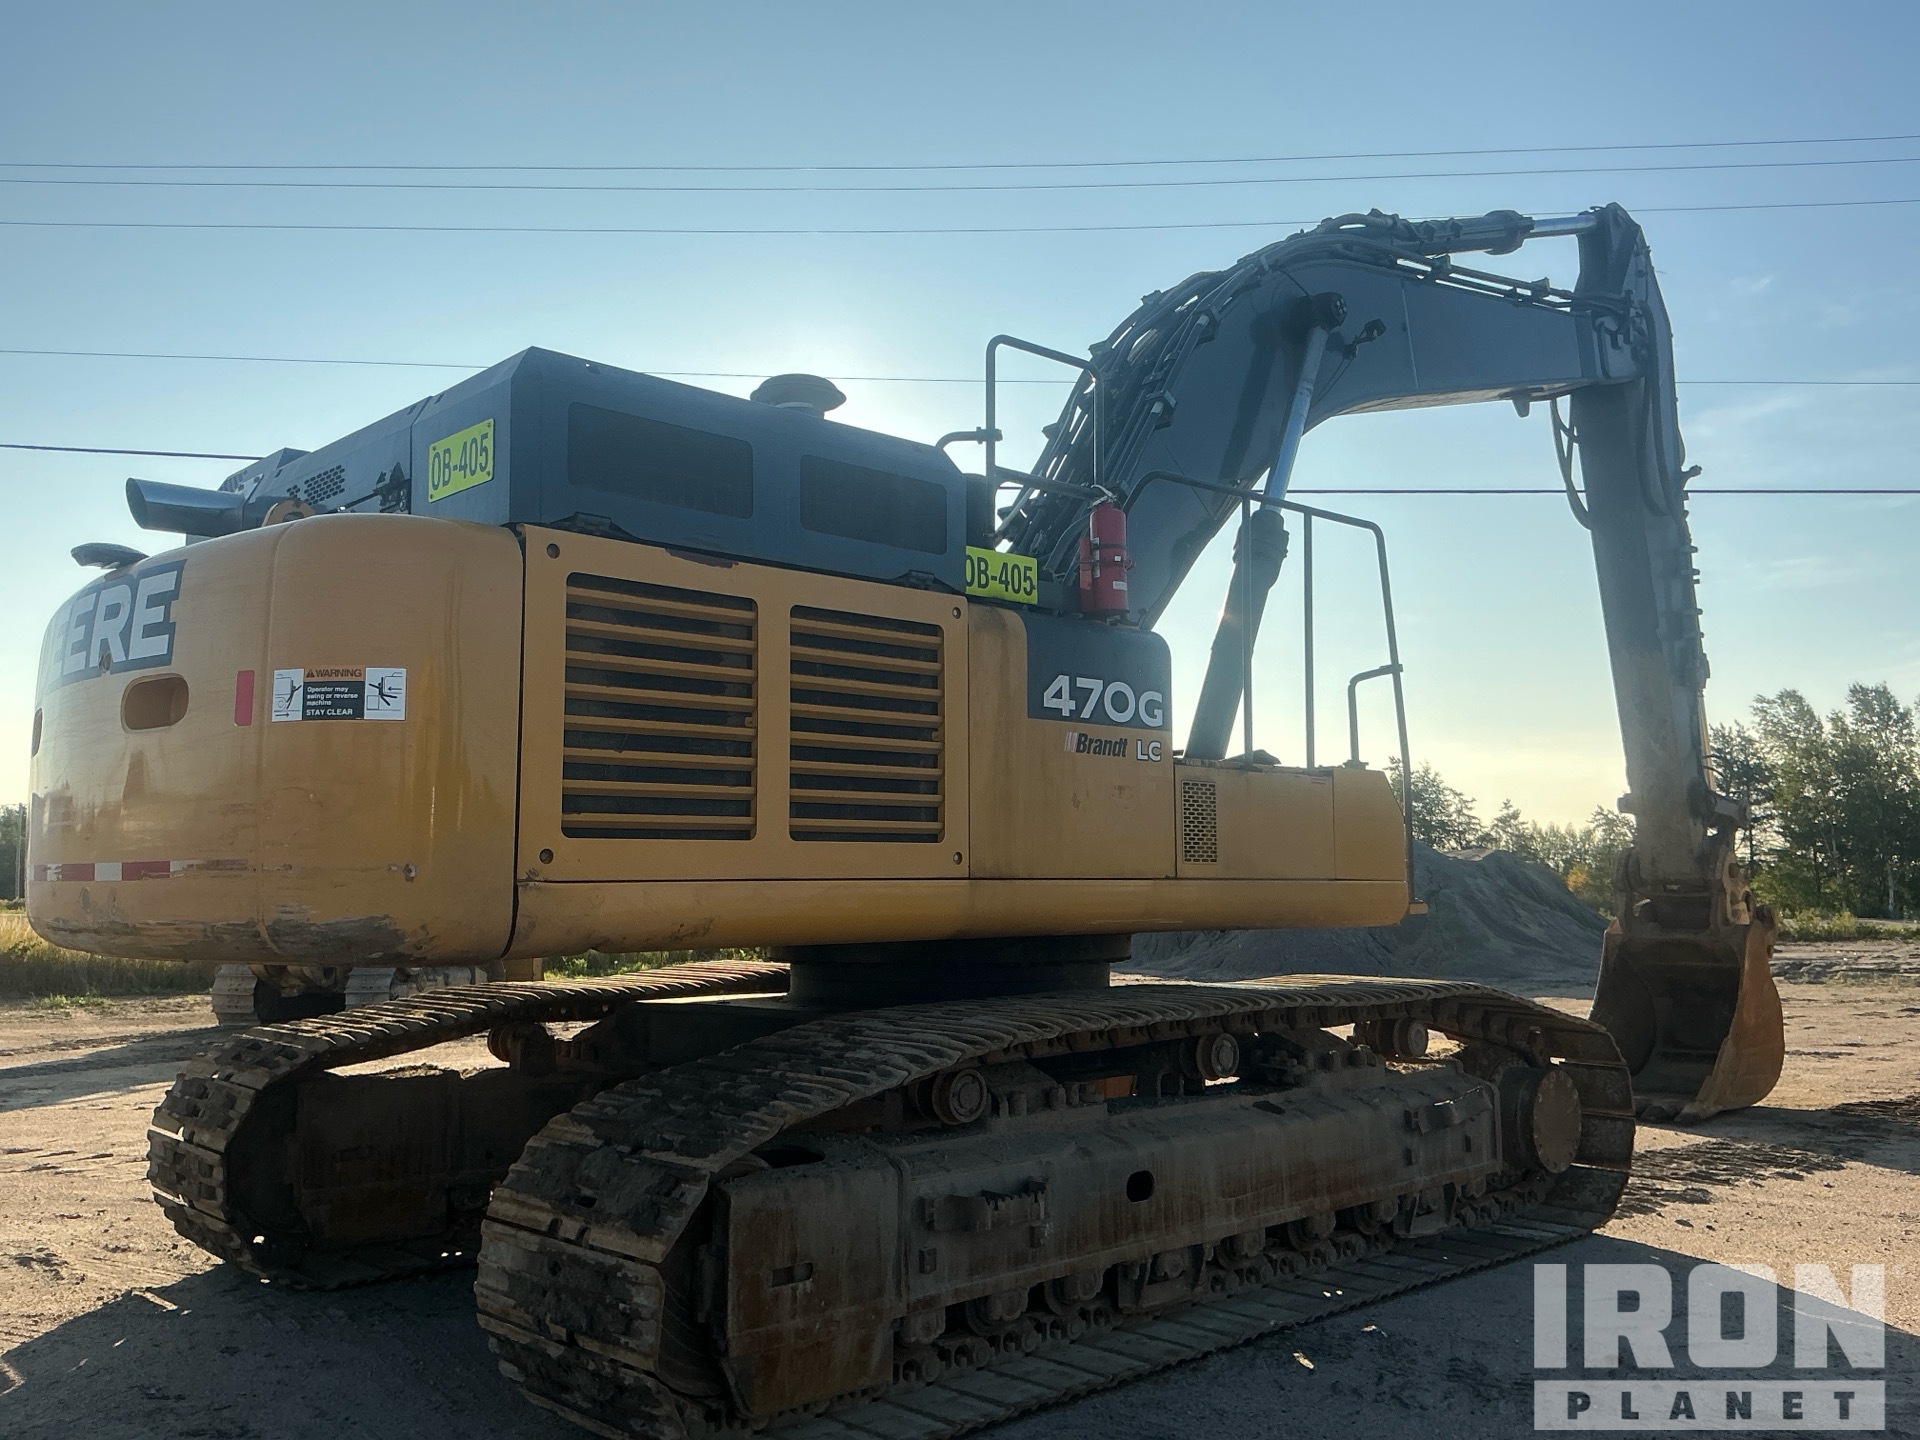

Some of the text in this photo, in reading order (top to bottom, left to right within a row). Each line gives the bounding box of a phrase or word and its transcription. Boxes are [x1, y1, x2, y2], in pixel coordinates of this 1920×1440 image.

[431, 432, 489, 491] OB-405
[315, 668, 362, 678] WARNING
[307, 686, 349, 694] Operator may
[1043, 674, 1164, 727] 470G
[326, 708, 353, 716] CLEAR
[1075, 732, 1162, 762] Brandt LC
